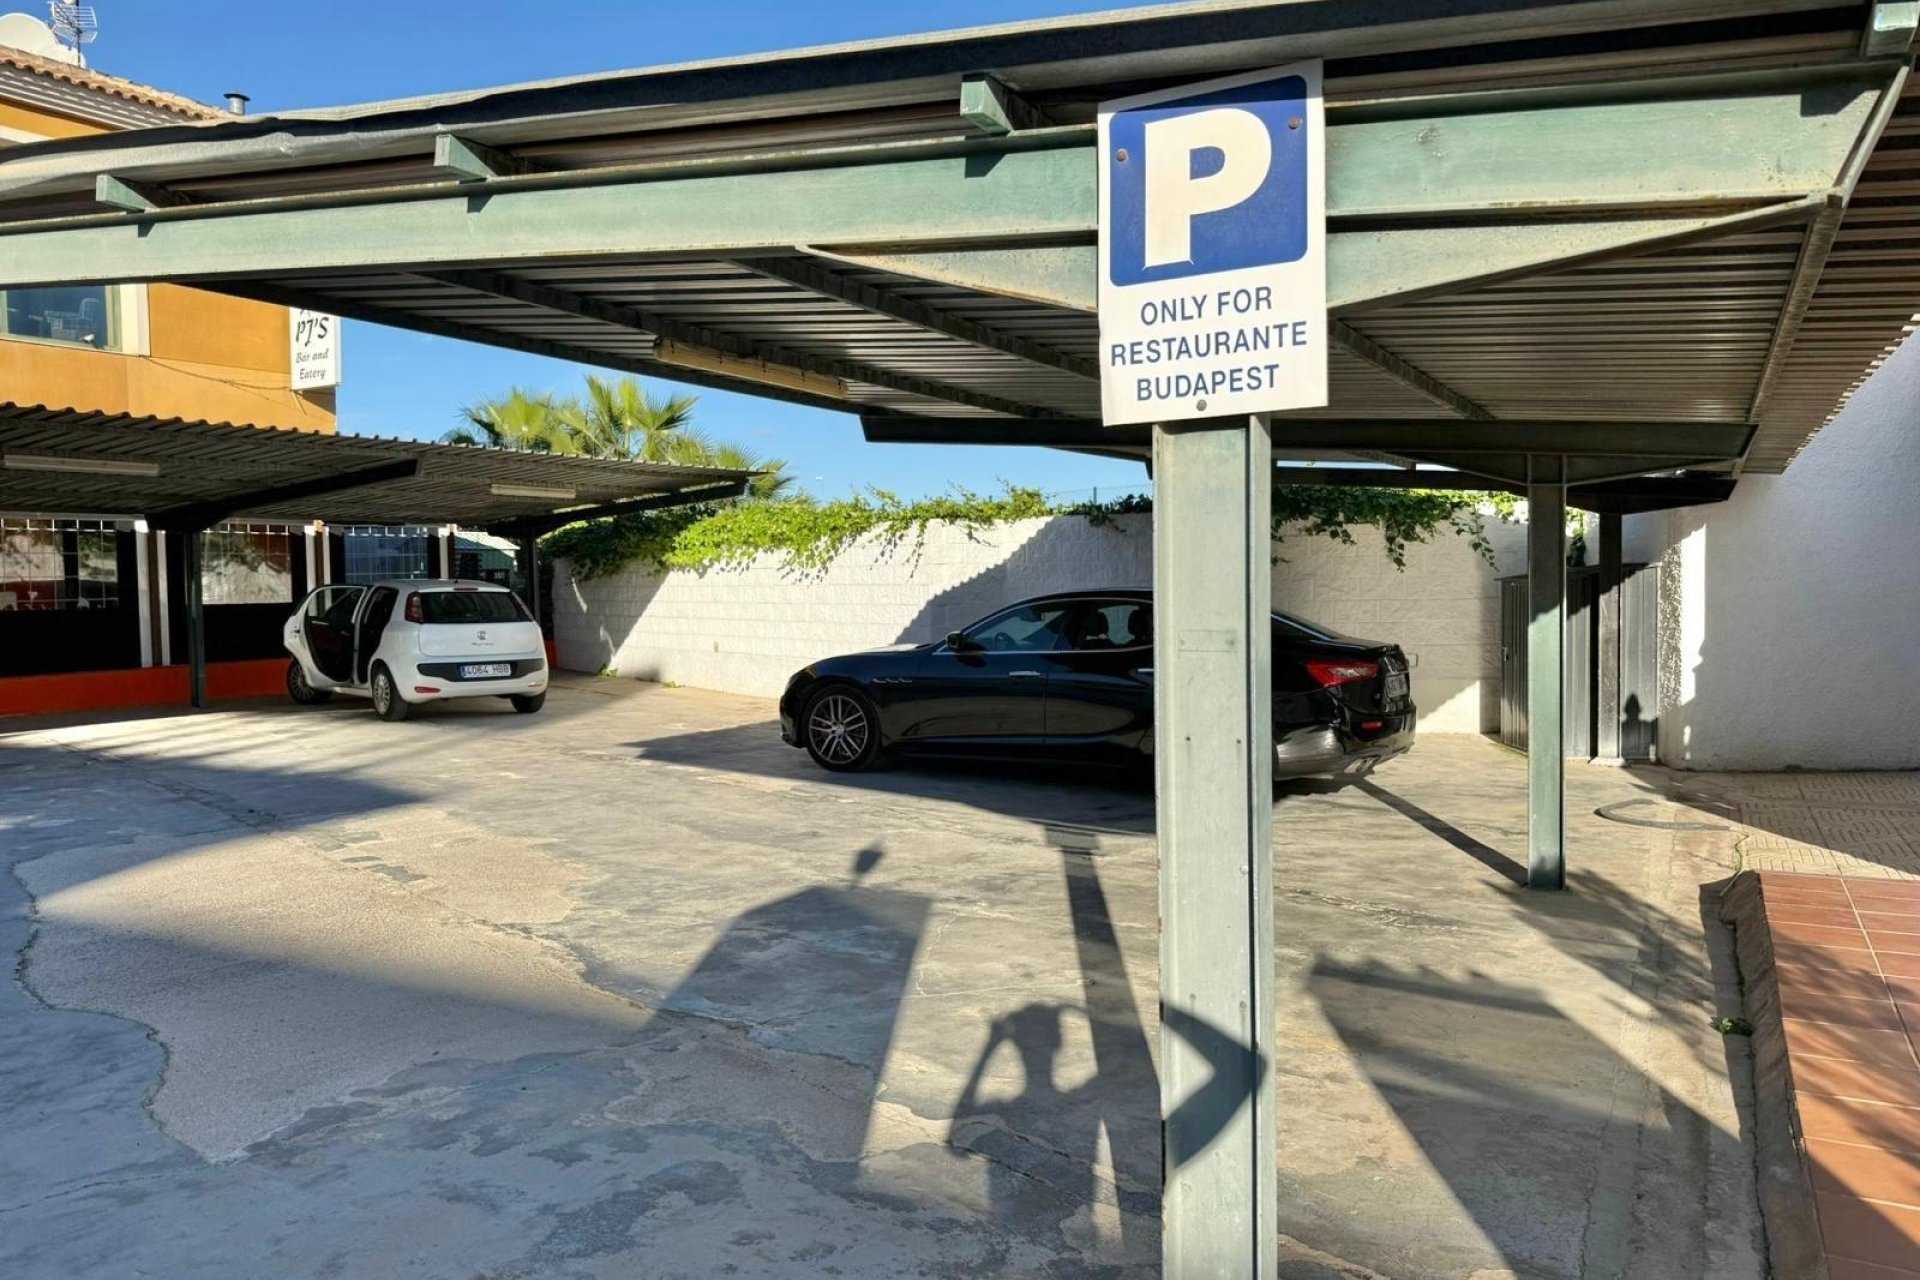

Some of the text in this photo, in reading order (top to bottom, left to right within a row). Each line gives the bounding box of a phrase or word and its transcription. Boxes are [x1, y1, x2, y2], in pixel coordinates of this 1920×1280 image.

[1142, 108, 1272, 271] P
[1141, 286, 1272, 326] ONLY FOR
[295, 348, 329, 364] Bar and
[1111, 320, 1308, 367] RESTAURANTE
[299, 368, 326, 381] Eatery
[1136, 363, 1280, 402] BUDAPEST
